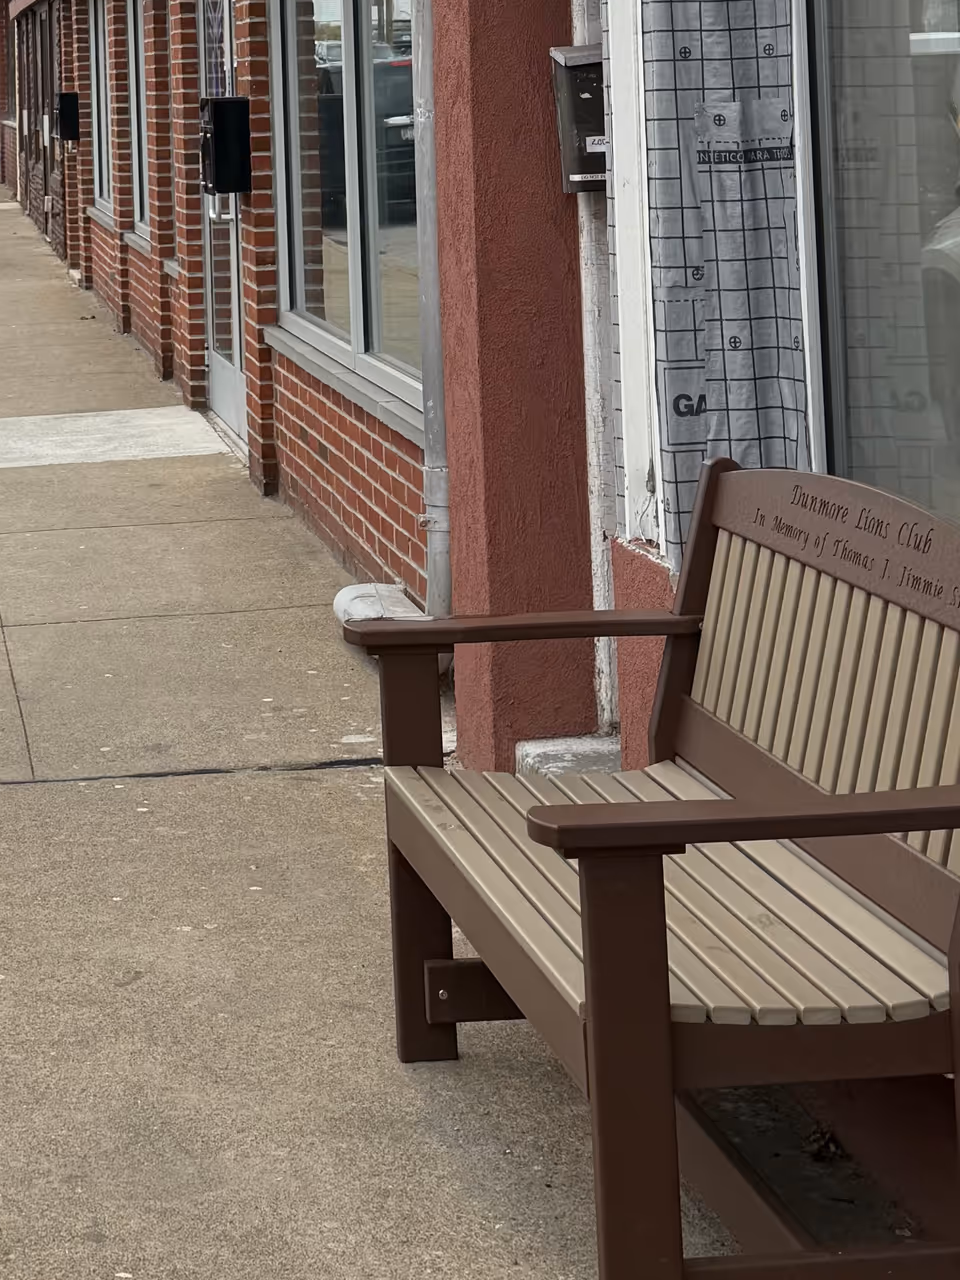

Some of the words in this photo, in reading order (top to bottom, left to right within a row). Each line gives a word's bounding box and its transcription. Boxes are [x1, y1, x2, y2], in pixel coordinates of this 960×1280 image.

[697, 151, 745, 162] INTÉTICO
[749, 151, 770, 161] ARA
[672, 394, 707, 418] GA
[790, 485, 849, 524] Dunmore
[855, 508, 890, 539] Lions
[898, 522, 934, 554] Club
[753, 507, 766, 527] In
[771, 516, 810, 551] Memory
[814, 532, 829, 558] of
[833, 539, 875, 571] Thomas
[896, 566, 944, 599] Jimmie
